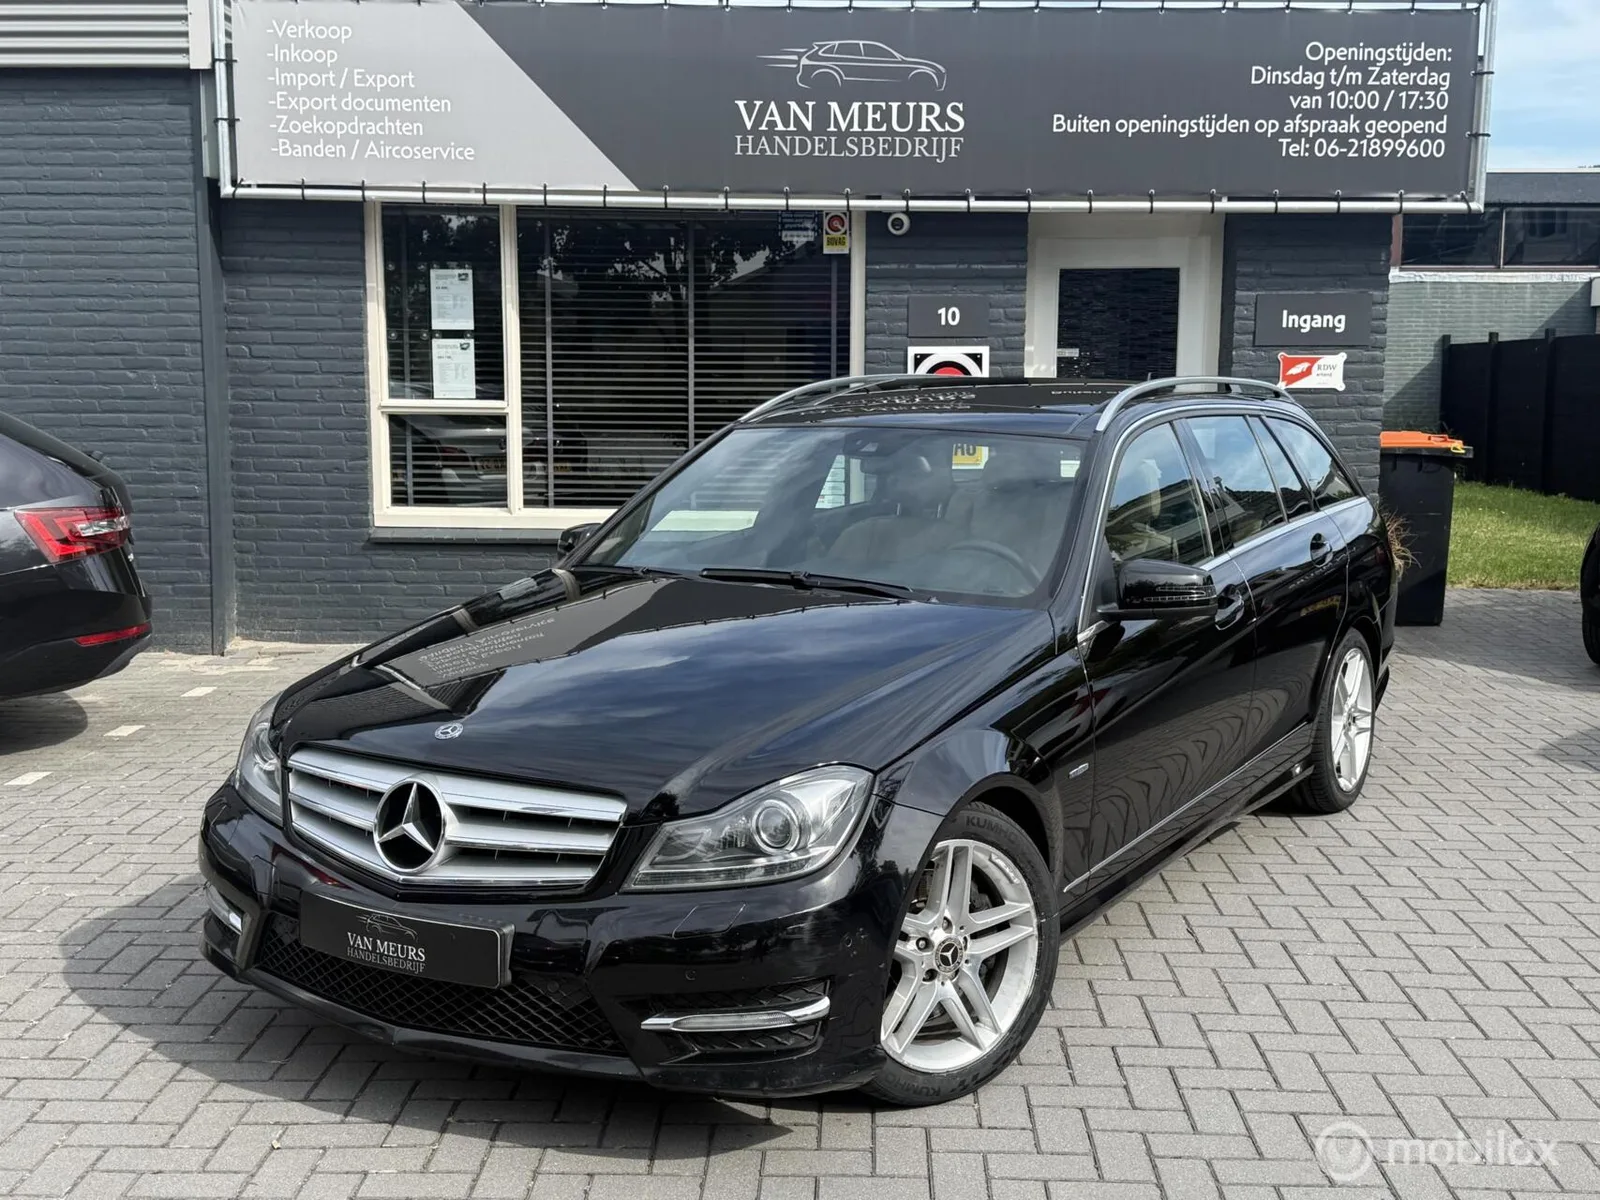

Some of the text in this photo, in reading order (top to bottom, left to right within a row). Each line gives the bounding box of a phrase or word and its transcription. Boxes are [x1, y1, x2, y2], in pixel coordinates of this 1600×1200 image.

[1305, 41, 1452, 63] Openingstijden:
[340, 67, 349, 89] /
[354, 69, 415, 91] Export
[1251, 66, 1451, 90] Dinsdag t/m Zaterdag
[341, 93, 451, 113] documenten
[1289, 91, 1449, 111] van 10:00 / 17:30
[734, 100, 965, 132] VAN MEURS
[1053, 114, 1448, 138] Buiten openingstijden op afspraak geopend
[351, 140, 360, 160] /
[365, 141, 475, 161] Aircoservice
[734, 135, 964, 163] HANDELSBEDRIJF
[1279, 138, 1446, 158] Tel: 06-21899600
[937, 306, 961, 326] 10
[1282, 309, 1346, 333] Ingang
[1317, 363, 1338, 371] RDW
[347, 931, 426, 961] VAN MEURS
[347, 947, 426, 974] HANDELSBEDRIJF
